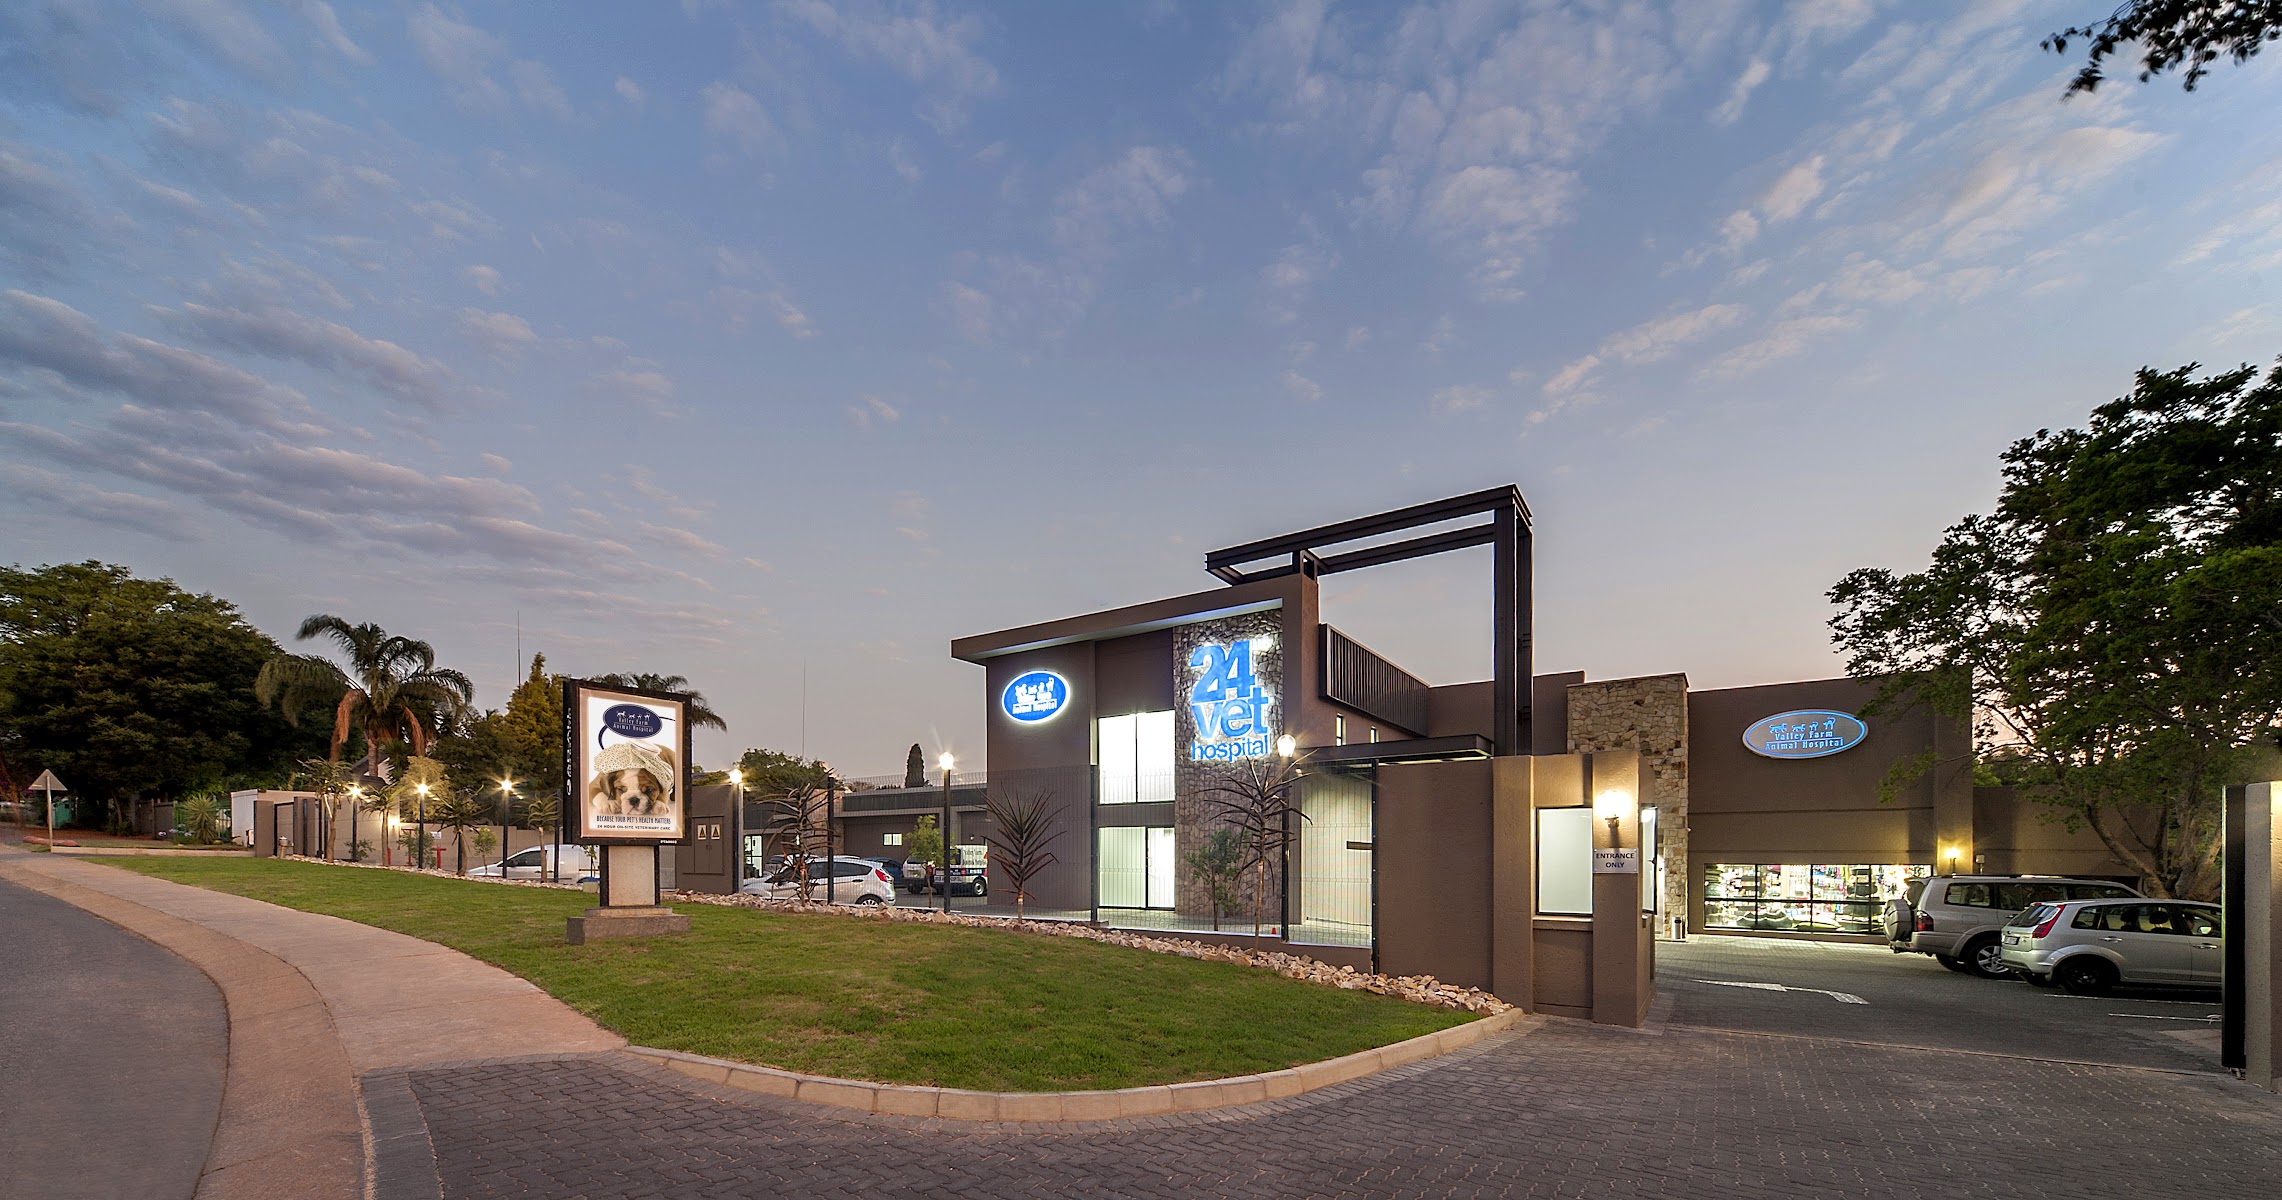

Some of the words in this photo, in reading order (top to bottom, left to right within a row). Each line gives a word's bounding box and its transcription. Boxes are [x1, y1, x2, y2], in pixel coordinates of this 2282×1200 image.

[1190, 640, 1256, 702] 24
[1191, 688, 1269, 738] vet
[632, 725, 654, 733] Hospital
[1774, 732, 1805, 741] Valley
[1809, 730, 1833, 738] Farm
[1191, 735, 1269, 763] hospital
[1765, 741, 1799, 751] Animal
[1802, 738, 1844, 749] Hospital
[596, 815, 614, 823] BECAUSE
[654, 817, 671, 825] MATTERS
